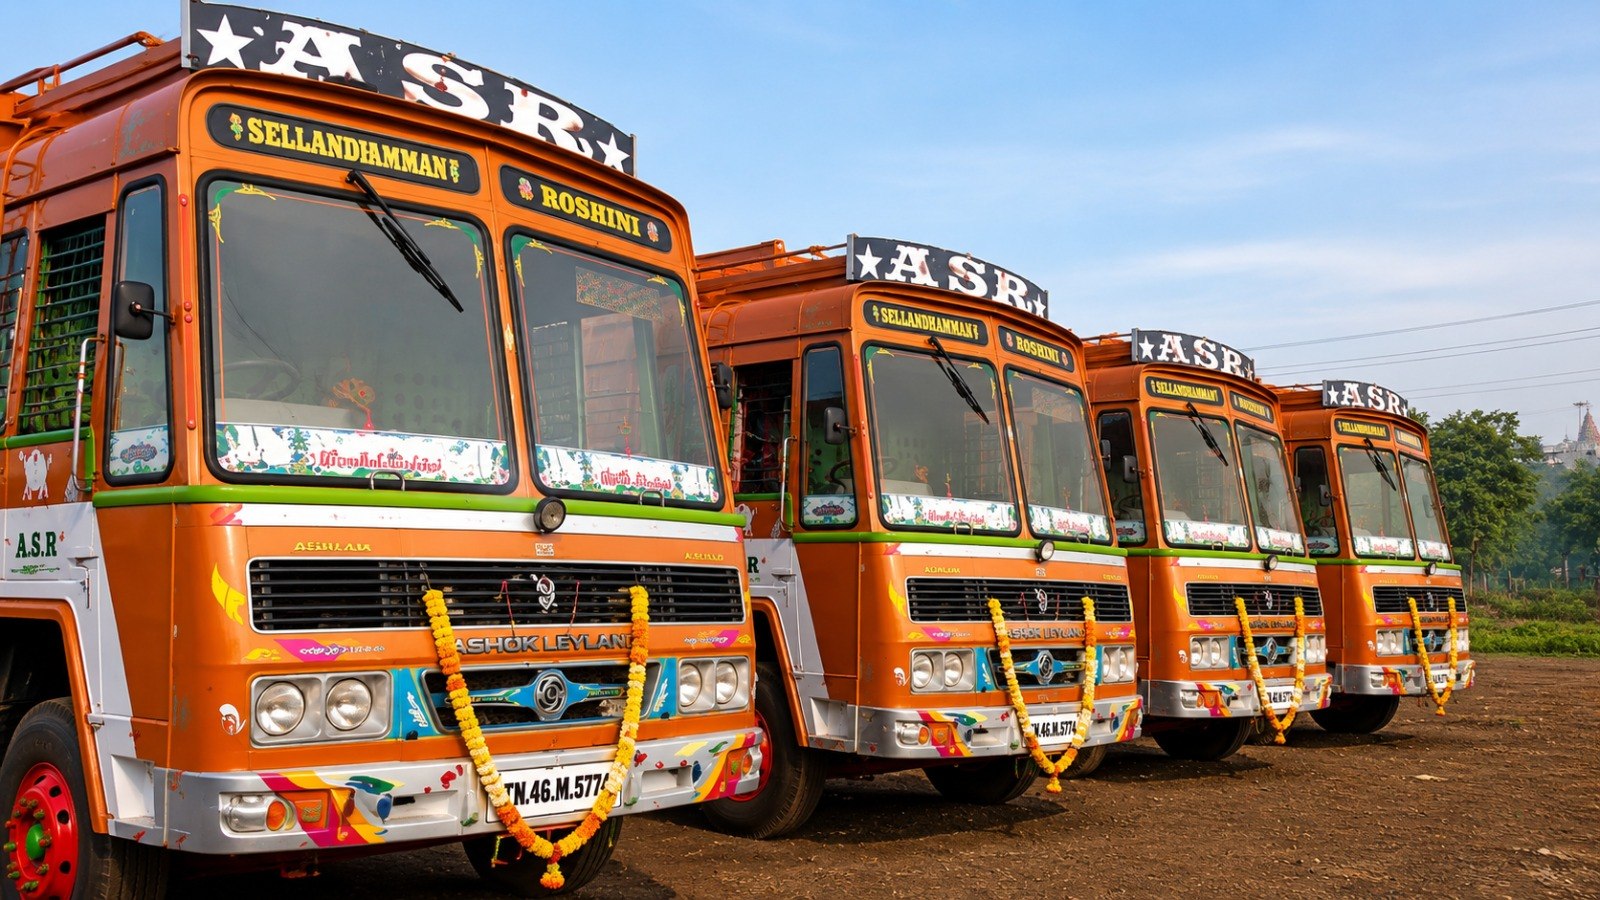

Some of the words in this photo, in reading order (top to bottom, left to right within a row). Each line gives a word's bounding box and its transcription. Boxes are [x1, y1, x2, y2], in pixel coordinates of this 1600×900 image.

[260, 20, 593, 157] ASR
[540, 184, 641, 237] ROSHINI
[885, 244, 1032, 310] ASR
[881, 307, 973, 340] SELLANDHAMMAN
[1016, 335, 1060, 364] ROSHINI
[1157, 334, 1245, 378] ASR
[1341, 382, 1401, 416] ASR
[15, 531, 57, 558] A.S.R
[455, 635, 540, 654] ASHOK
